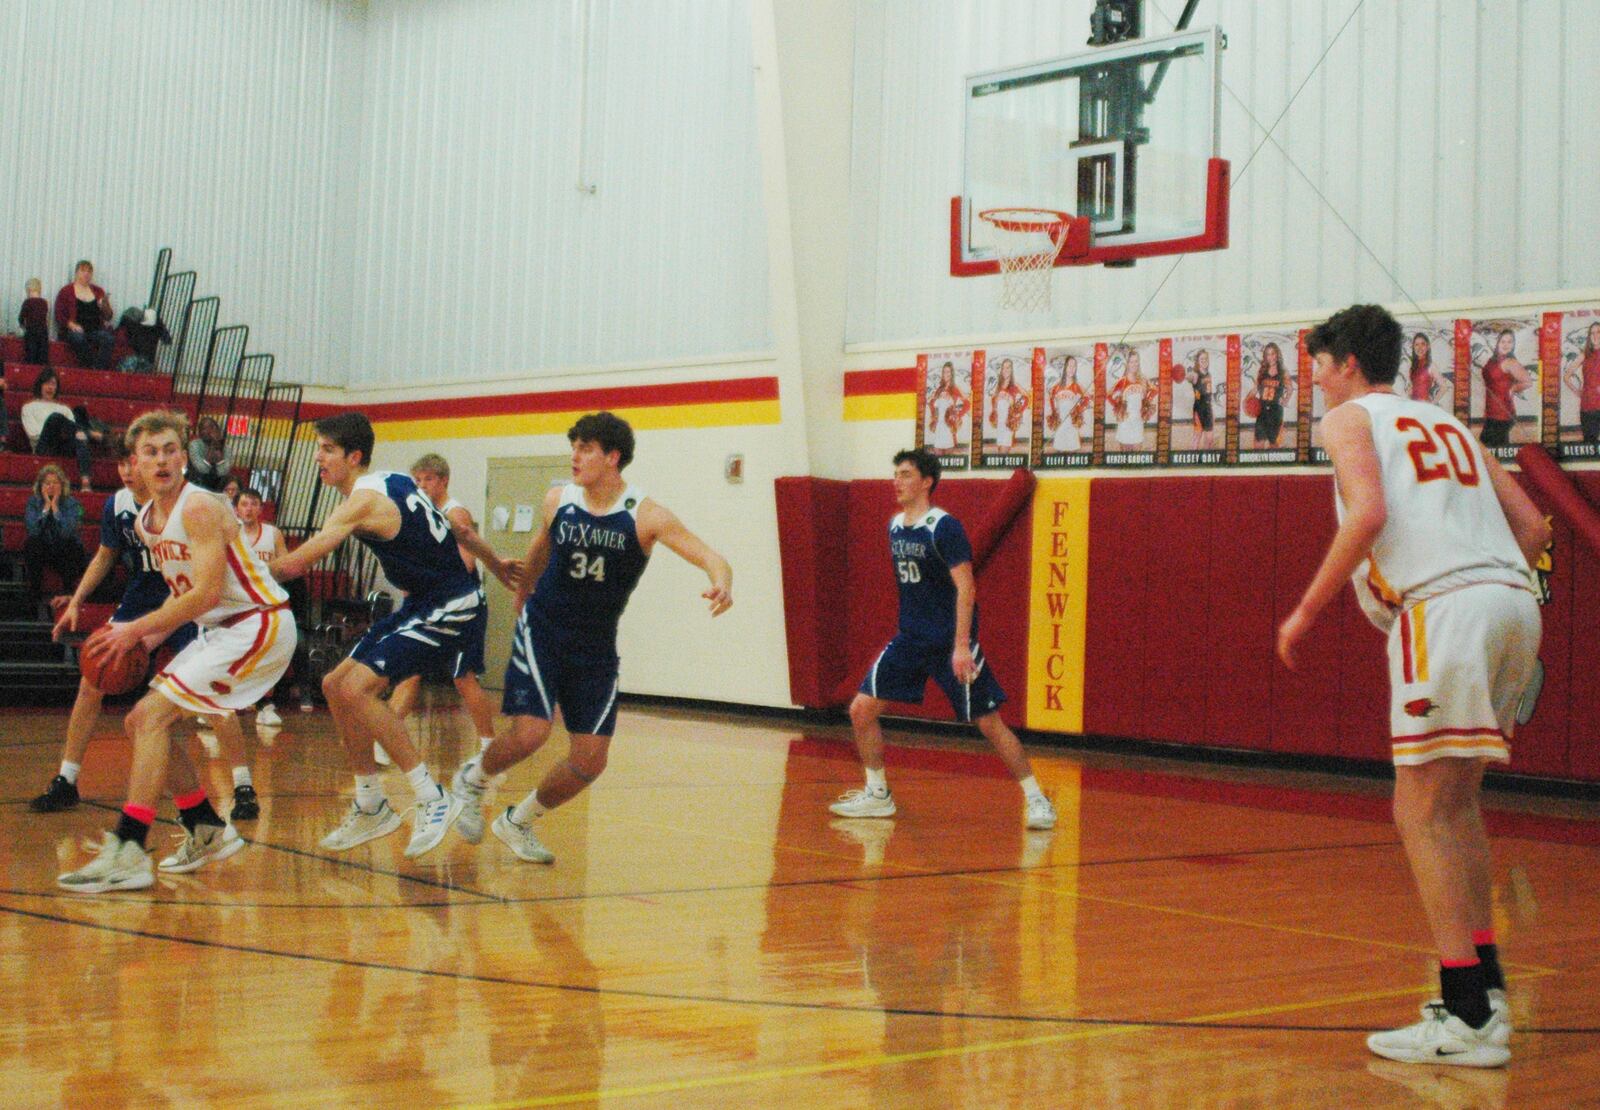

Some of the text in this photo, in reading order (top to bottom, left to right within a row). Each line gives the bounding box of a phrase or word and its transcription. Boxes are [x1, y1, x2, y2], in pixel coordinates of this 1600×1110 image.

[1173, 453, 1200, 463] KELSEY
[1396, 417, 1479, 486] 20
[1564, 445, 1595, 456] ALEXIS
[570, 552, 606, 582] 34
[898, 561, 921, 584] 50
[1044, 501, 1069, 711] FENWICK
